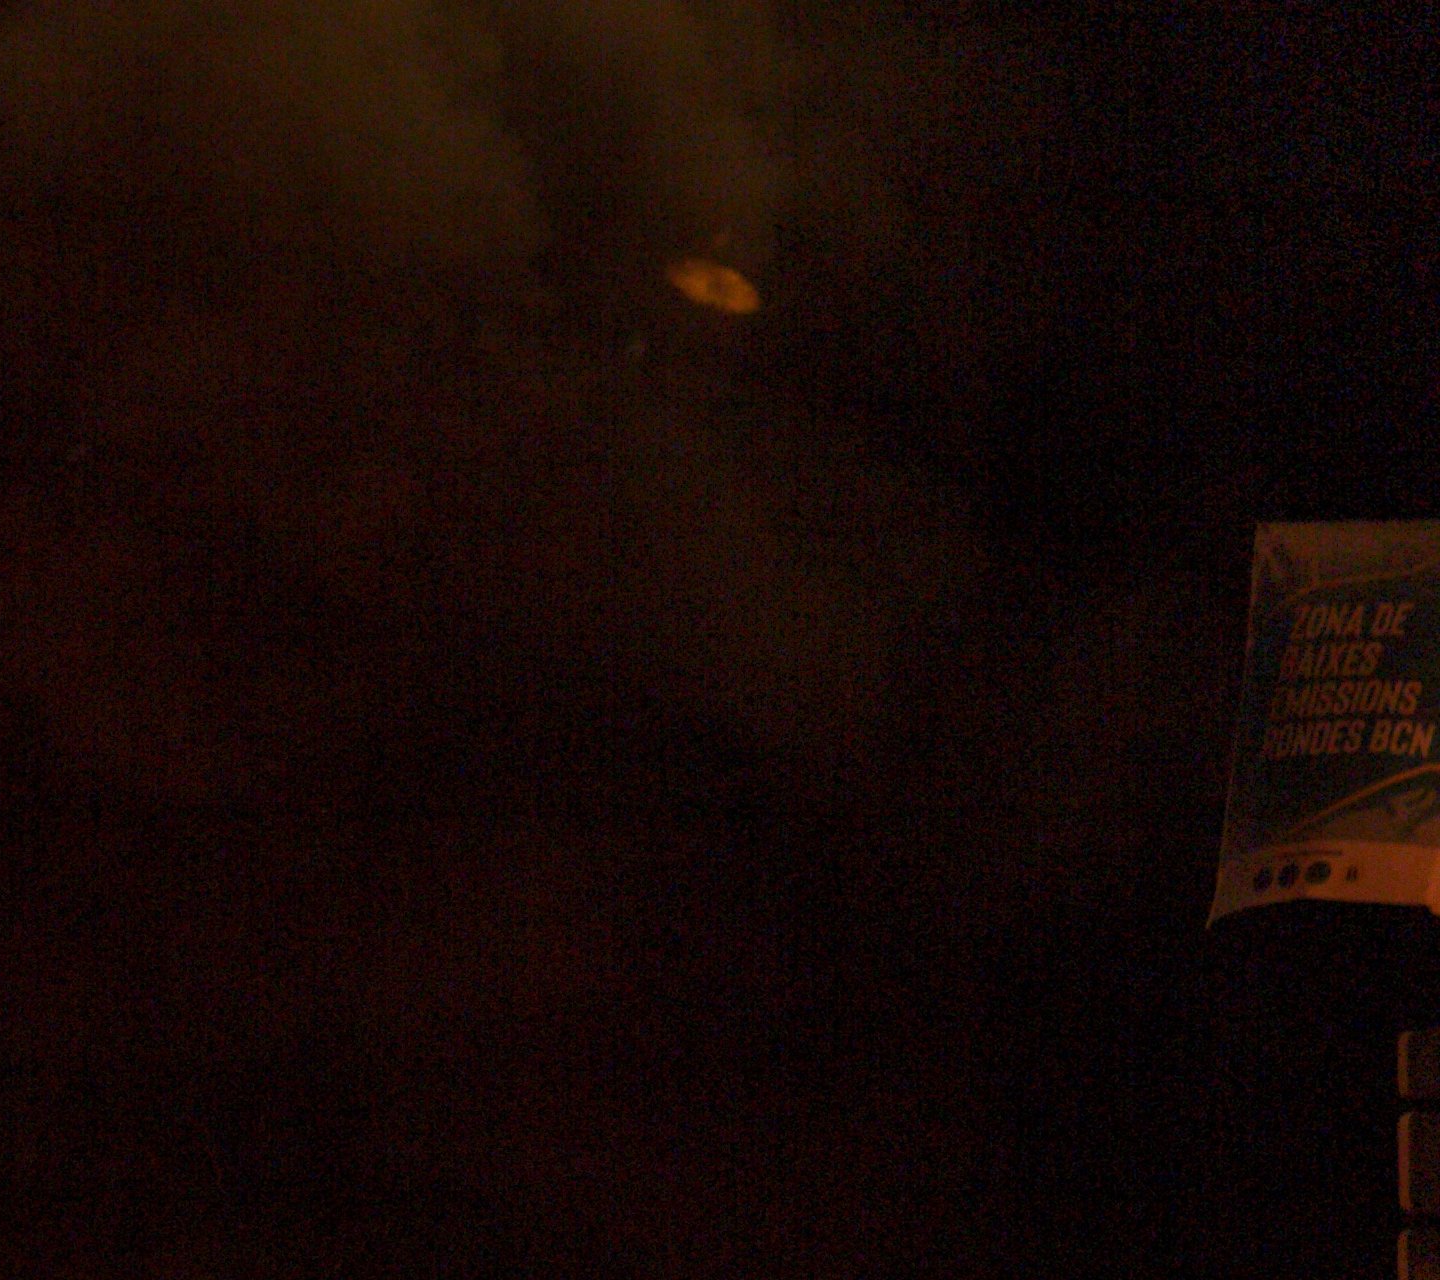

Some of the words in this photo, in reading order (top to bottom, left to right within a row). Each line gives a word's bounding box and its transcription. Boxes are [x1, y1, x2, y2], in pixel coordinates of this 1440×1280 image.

[1290, 603, 1364, 639] ZONA
[1371, 601, 1415, 637] DE
[1279, 642, 1383, 682] BAIXES
[1269, 679, 1422, 721] EMISSIONS
[1260, 719, 1366, 759] RONDES
[1368, 719, 1435, 758] BCN
